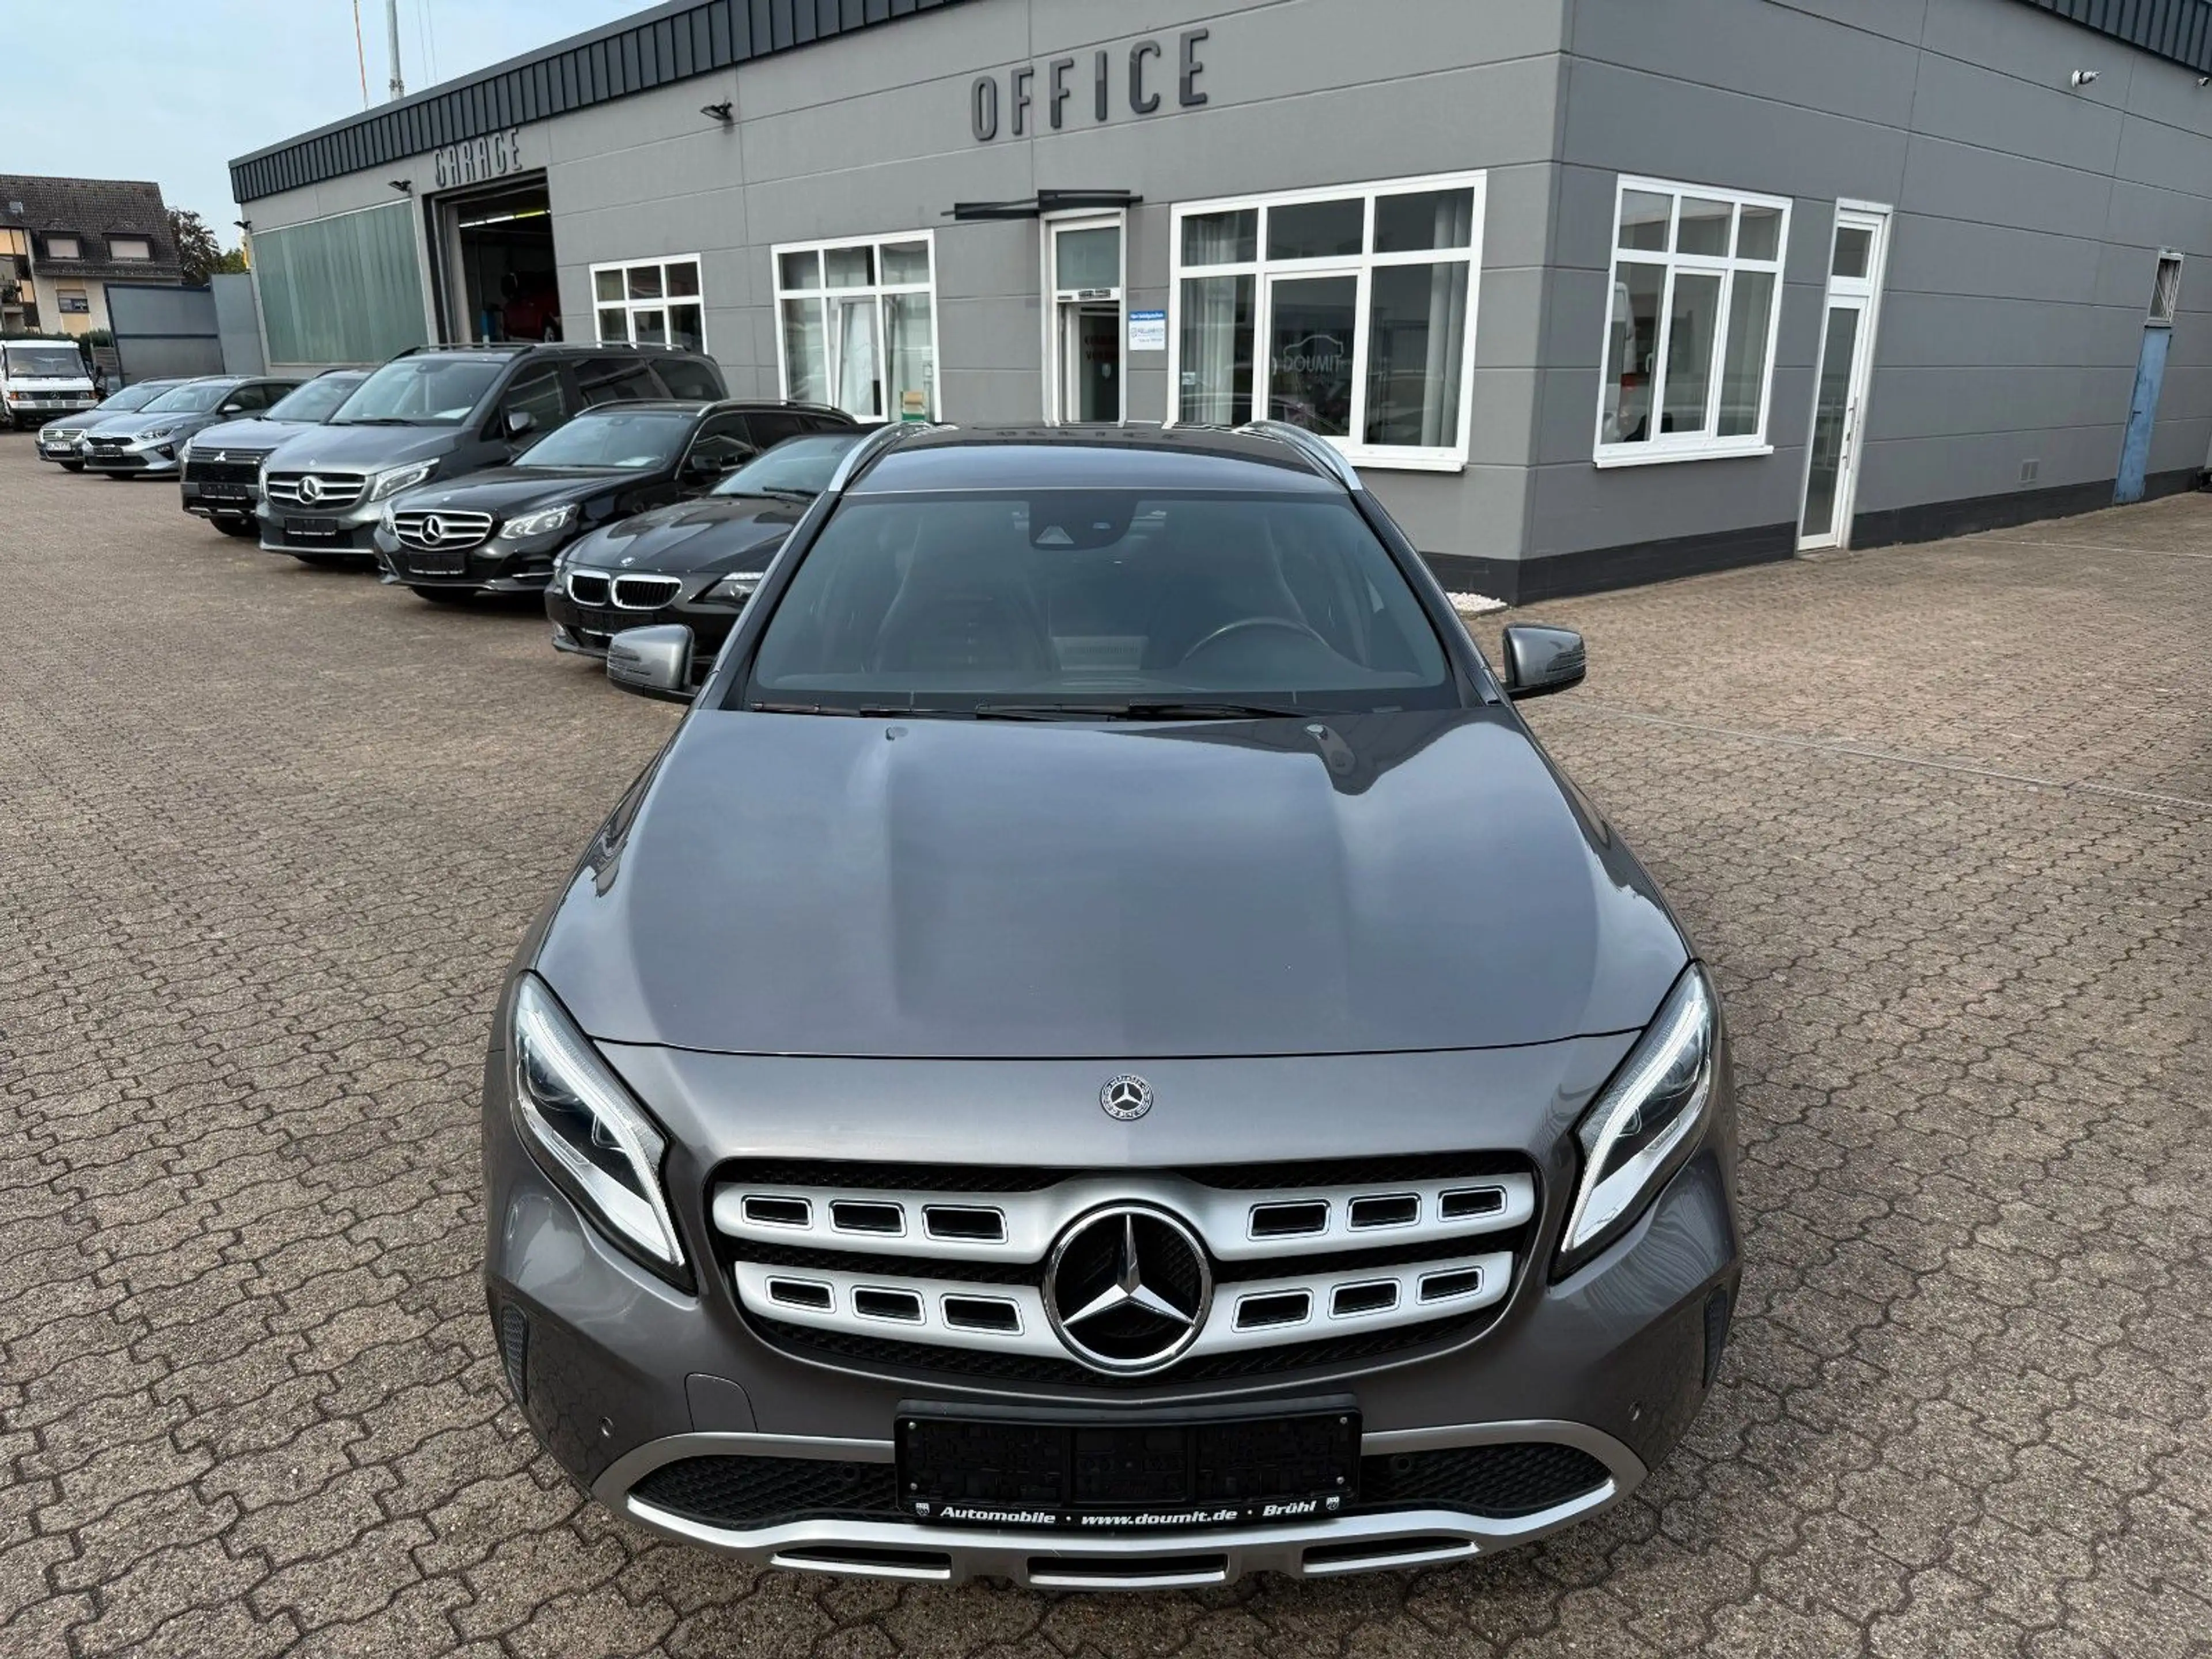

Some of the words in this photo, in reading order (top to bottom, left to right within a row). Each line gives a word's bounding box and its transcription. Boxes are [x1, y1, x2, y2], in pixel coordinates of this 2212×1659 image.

[971, 28, 1209, 141] OFFICE
[434, 127, 522, 188] GARAGE
[1283, 354, 1339, 373] DOUMIT
[940, 1506, 1056, 1524] Automobile
[1081, 1509, 1238, 1525] www.doumit.de
[1263, 1500, 1317, 1517] Brühl
